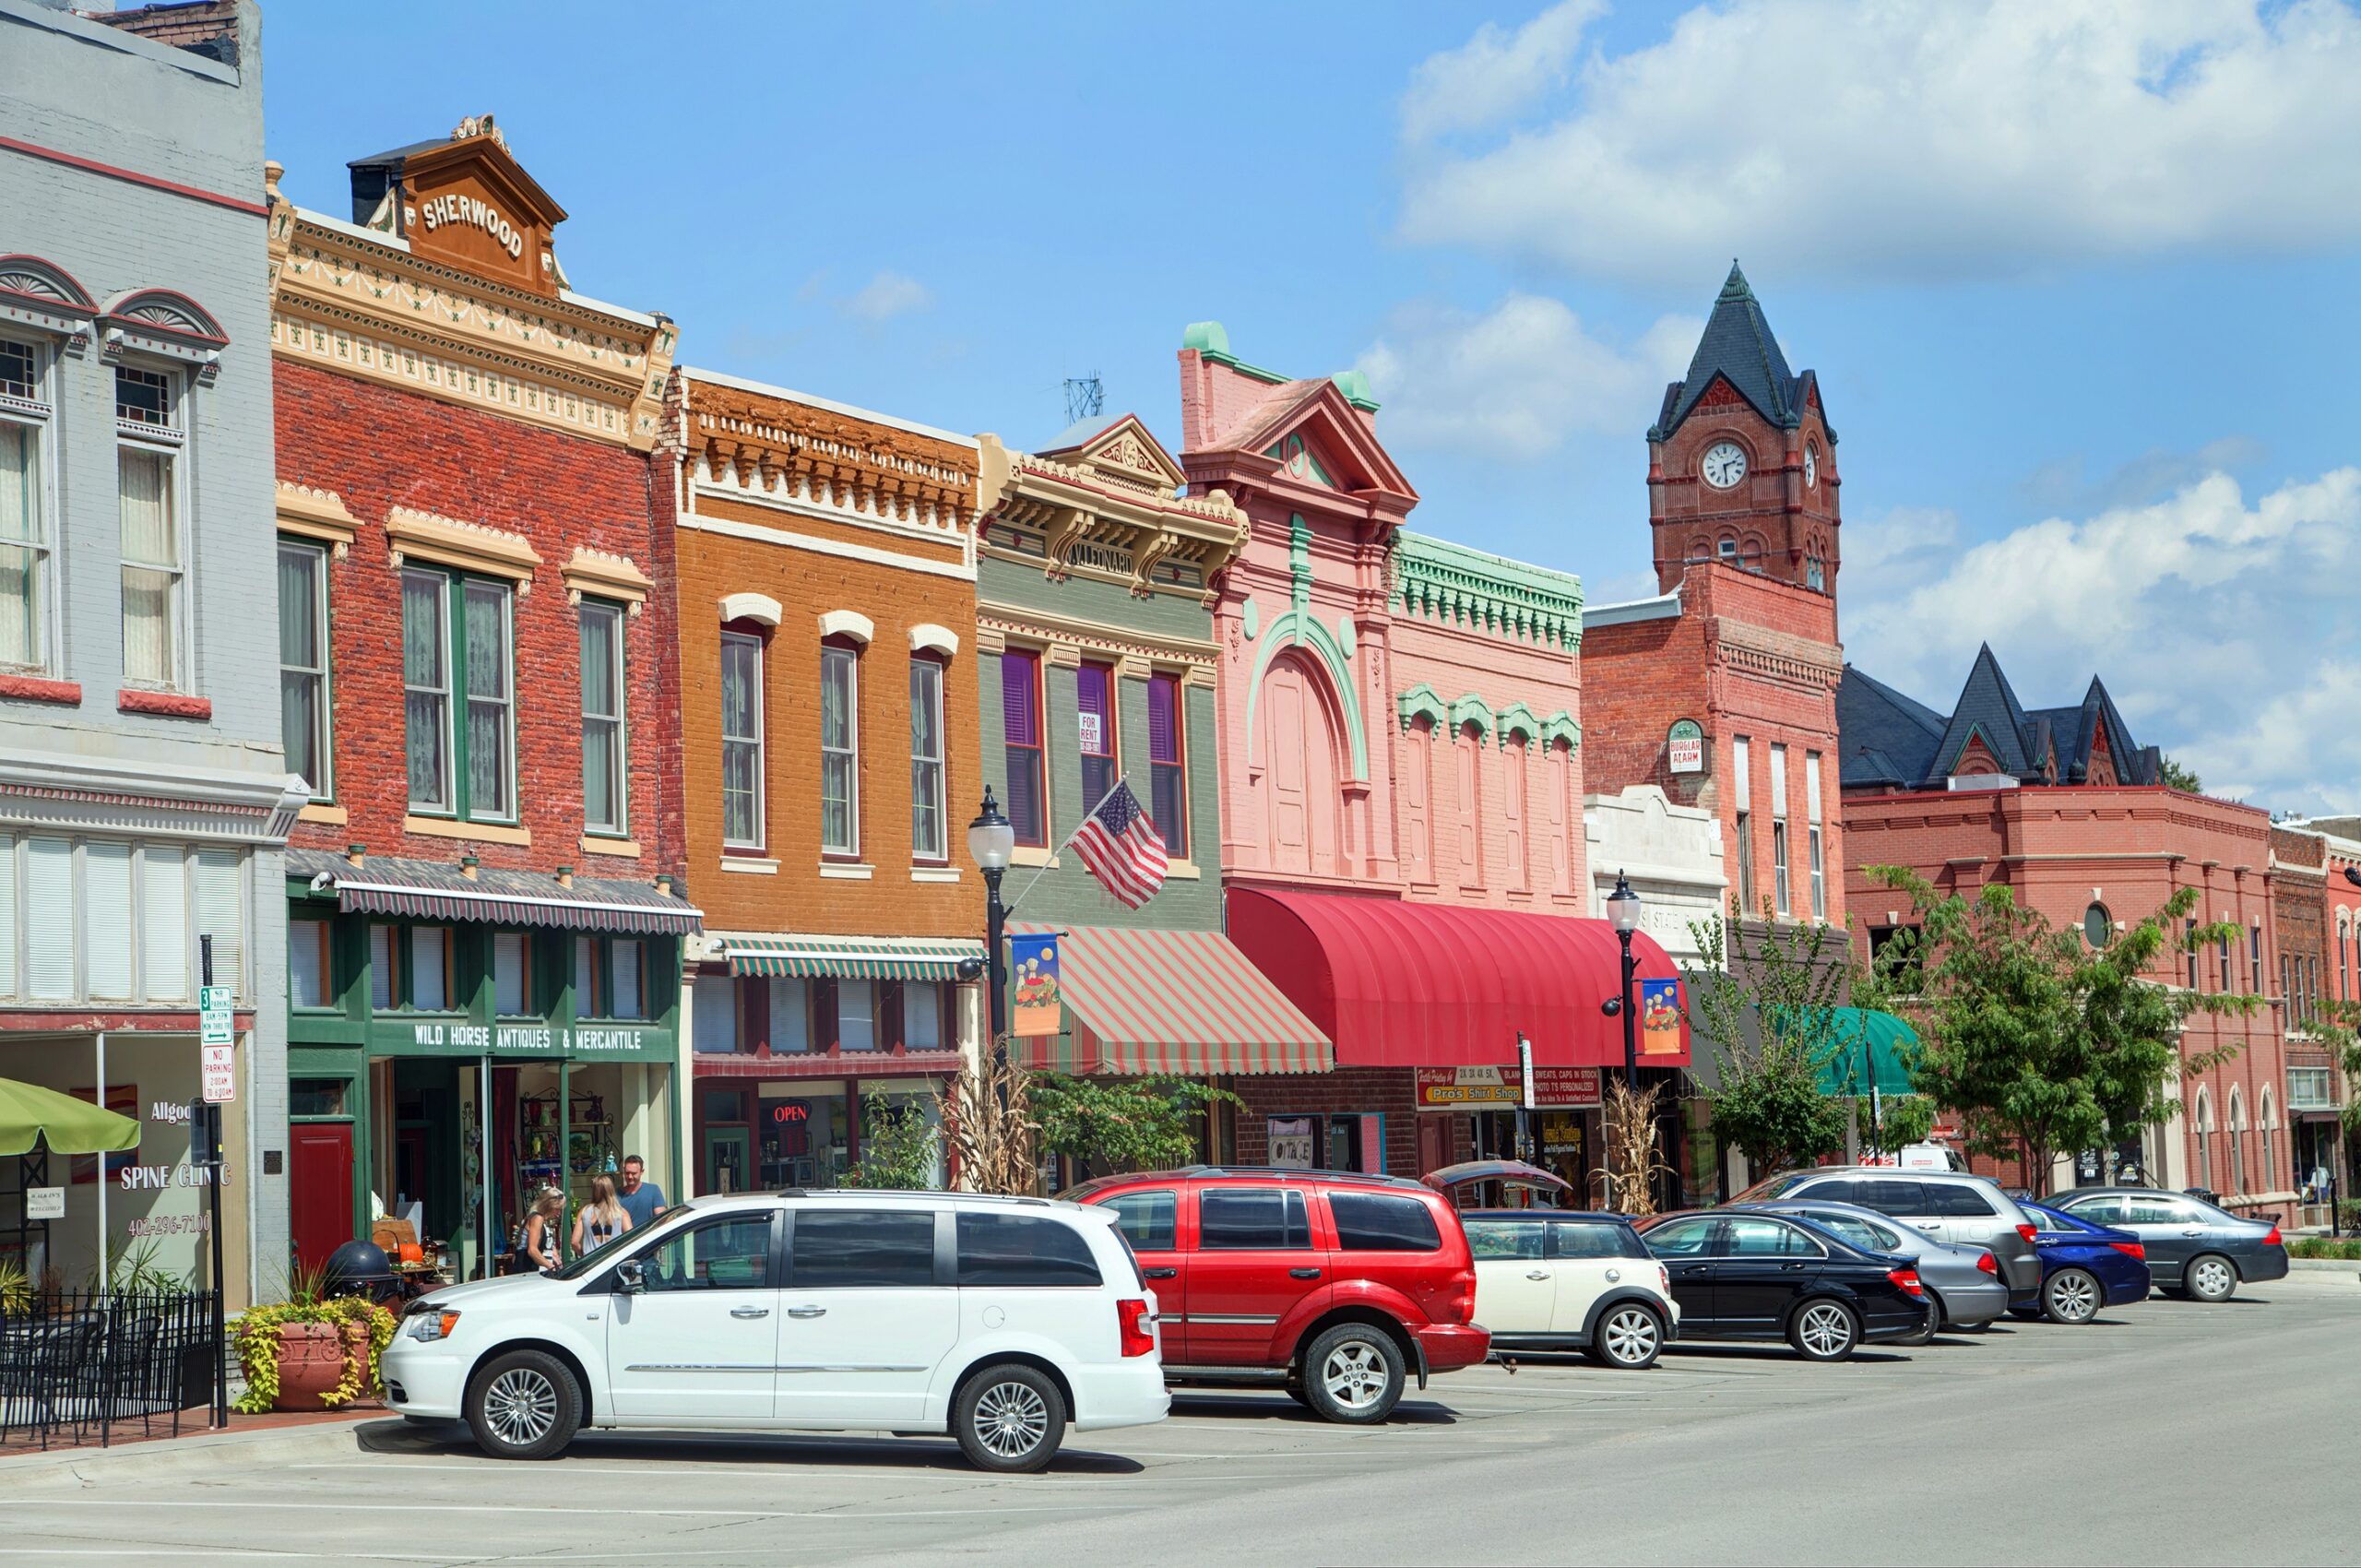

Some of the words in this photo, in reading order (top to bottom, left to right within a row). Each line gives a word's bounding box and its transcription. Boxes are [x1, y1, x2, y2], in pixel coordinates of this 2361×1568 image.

[422, 194, 522, 257] SHERWOOD
[1083, 717, 1096, 729] FOR
[1080, 729, 1097, 741] RENT
[1670, 741, 1701, 752] BURGLAR
[1674, 753, 1698, 764] ALARM
[202, 990, 209, 1008] 3
[414, 1025, 444, 1046] WILD
[451, 1026, 490, 1047] HORSE
[496, 1028, 551, 1049] ANTIQUES
[563, 1028, 570, 1048] &
[575, 1030, 642, 1050] MERCANTILE
[213, 1050, 222, 1060] NO
[206, 1063, 231, 1074] PARKING
[1460, 1069, 1467, 1078] 2X
[1469, 1069, 1476, 1078] 3X
[1477, 1069, 1484, 1078] 4X
[1559, 1070, 1573, 1078] CAPS
[1574, 1070, 1580, 1078] IN
[1581, 1070, 1598, 1078] STOCK
[210, 1077, 228, 1086] 2:00AM
[1560, 1082, 1594, 1092] PERSONALIZED
[207, 1088, 214, 1097] TO
[1433, 1088, 1463, 1099] Pro's
[1468, 1088, 1490, 1099] Shirt
[1495, 1088, 1519, 1101] Shop
[151, 1101, 191, 1124] Allgoo
[775, 1106, 807, 1123] OPEN
[1271, 1140, 1310, 1162] COTTAGE
[121, 1165, 170, 1190] SPINE
[178, 1163, 231, 1188] CLINC
[128, 1214, 211, 1237] 402-296-7100
